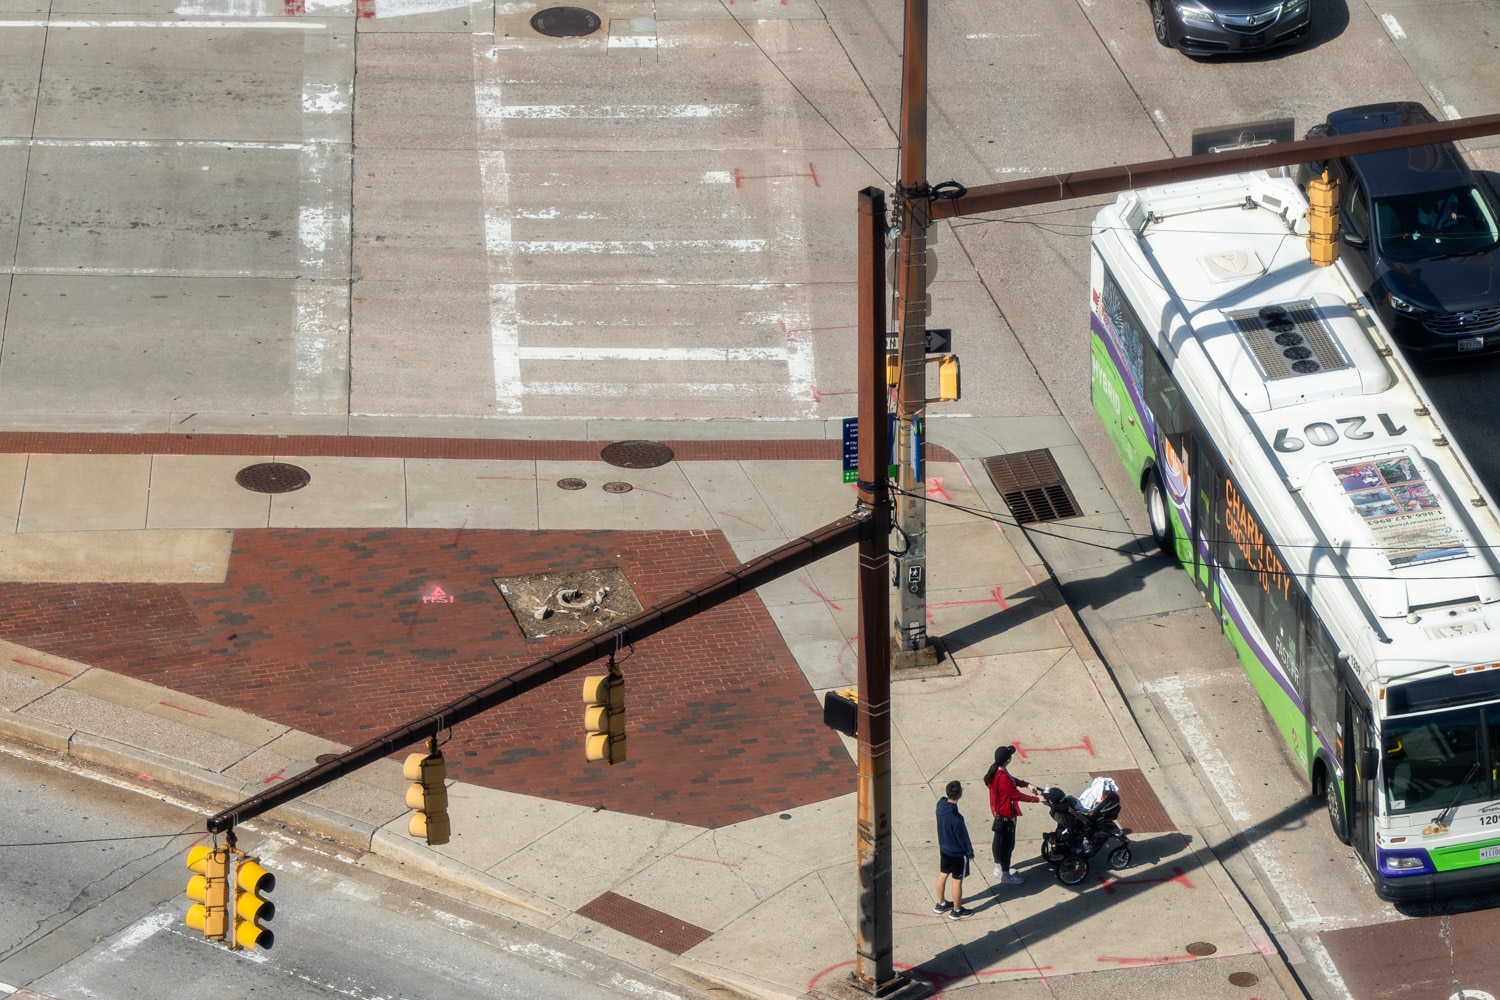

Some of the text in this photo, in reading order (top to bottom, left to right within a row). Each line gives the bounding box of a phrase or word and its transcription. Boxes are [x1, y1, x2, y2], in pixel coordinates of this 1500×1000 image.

[1092, 355, 1121, 415] HYBRID
[1273, 413, 1407, 453] 1209
[1225, 478, 1291, 602] CHARM CITY
[1225, 508, 1270, 595] CIRCULTO
